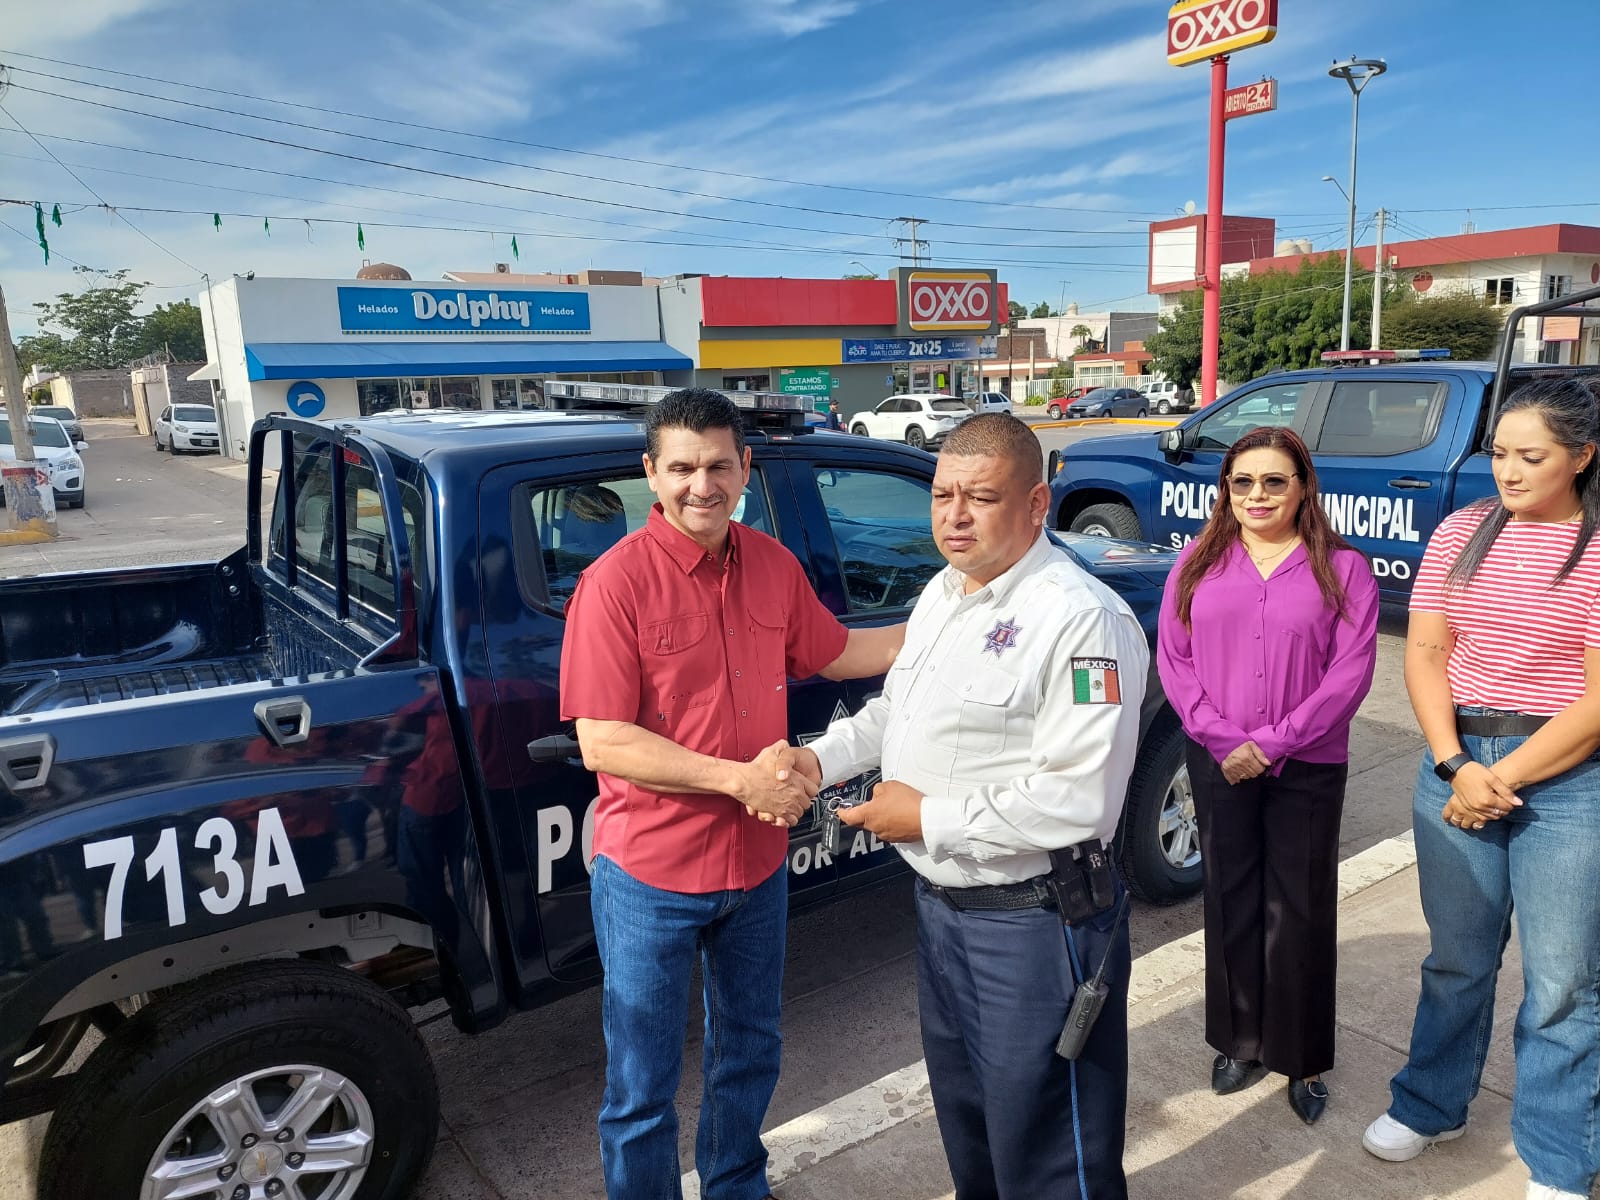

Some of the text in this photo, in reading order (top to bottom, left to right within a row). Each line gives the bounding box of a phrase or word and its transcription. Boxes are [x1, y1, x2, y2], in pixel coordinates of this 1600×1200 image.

[1171, 0, 1265, 50] OXXO
[1225, 84, 1270, 112] ABIERTO 24
[1247, 101, 1270, 111] HORAS
[358, 304, 399, 314] Helados
[411, 291, 530, 327] Dolphy
[541, 306, 575, 316] Helados
[913, 284, 989, 322] OXXO
[784, 384, 827, 392] CONTRATANDO
[789, 376, 822, 385] ESTAMOS
[1161, 481, 1420, 542] POLIC NICIPAL
[1073, 658, 1117, 671] MÉXICO
[83, 807, 305, 941] 713A
